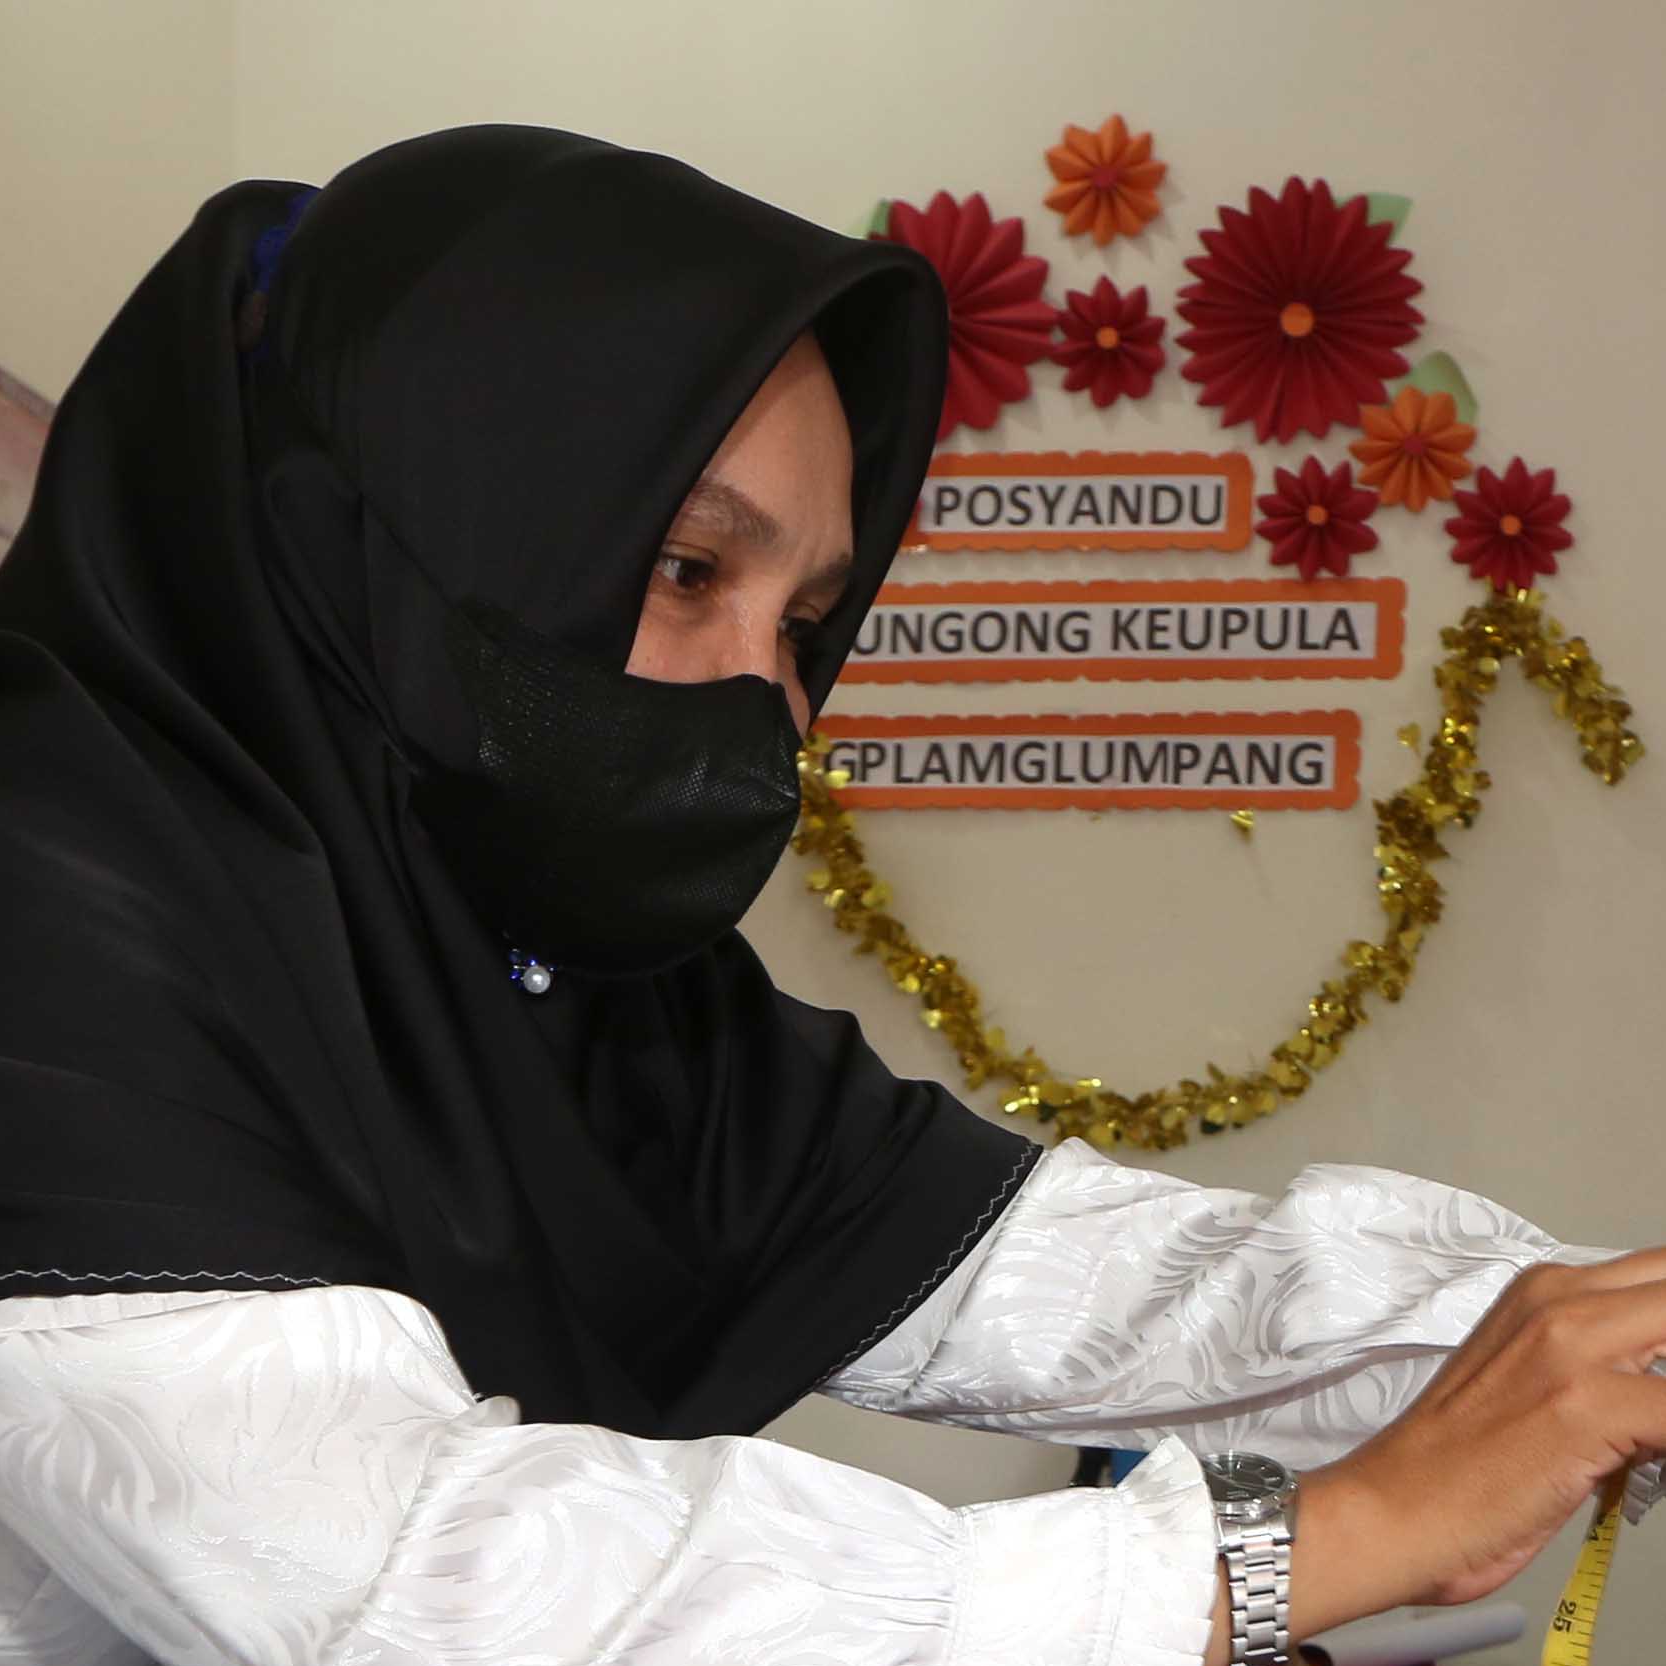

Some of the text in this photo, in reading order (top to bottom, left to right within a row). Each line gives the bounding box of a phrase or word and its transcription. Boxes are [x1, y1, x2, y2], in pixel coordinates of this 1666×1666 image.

[933, 484, 1224, 527] POSYANDU
[1111, 607, 1361, 653] KEUPULA
[1553, 1599, 1577, 1632] 25
